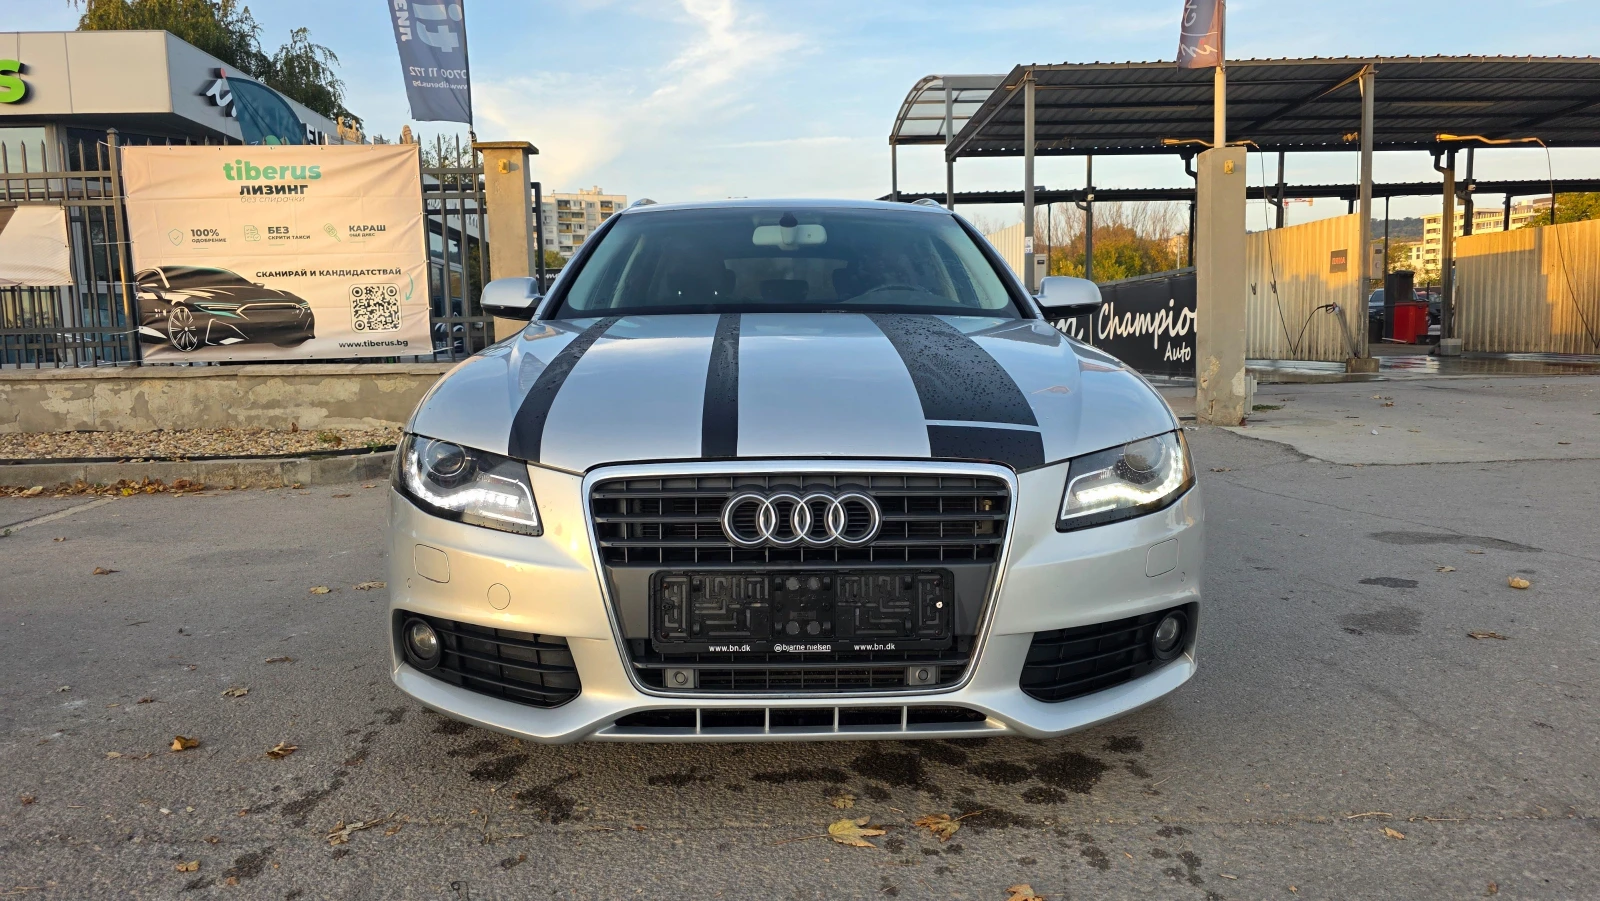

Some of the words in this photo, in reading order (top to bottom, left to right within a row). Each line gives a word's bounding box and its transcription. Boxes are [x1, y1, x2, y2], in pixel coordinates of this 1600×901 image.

[223, 159, 322, 181] tiberus
[190, 228, 220, 237] 100%
[267, 226, 290, 235] БЕЗ
[348, 224, 386, 232] КАРАШ
[255, 268, 308, 278] СКАНИРАЙ
[310, 269, 317, 277] И
[319, 267, 402, 277] КАНДИДАТСТВАЙ
[1098, 298, 1197, 350] Champio
[338, 339, 409, 349] www.tiberus.bg
[1163, 341, 1192, 363] Auto
[708, 644, 751, 652] www.bn.dk
[806, 643, 832, 651] nielsen
[853, 643, 896, 651] www.bn.dk
